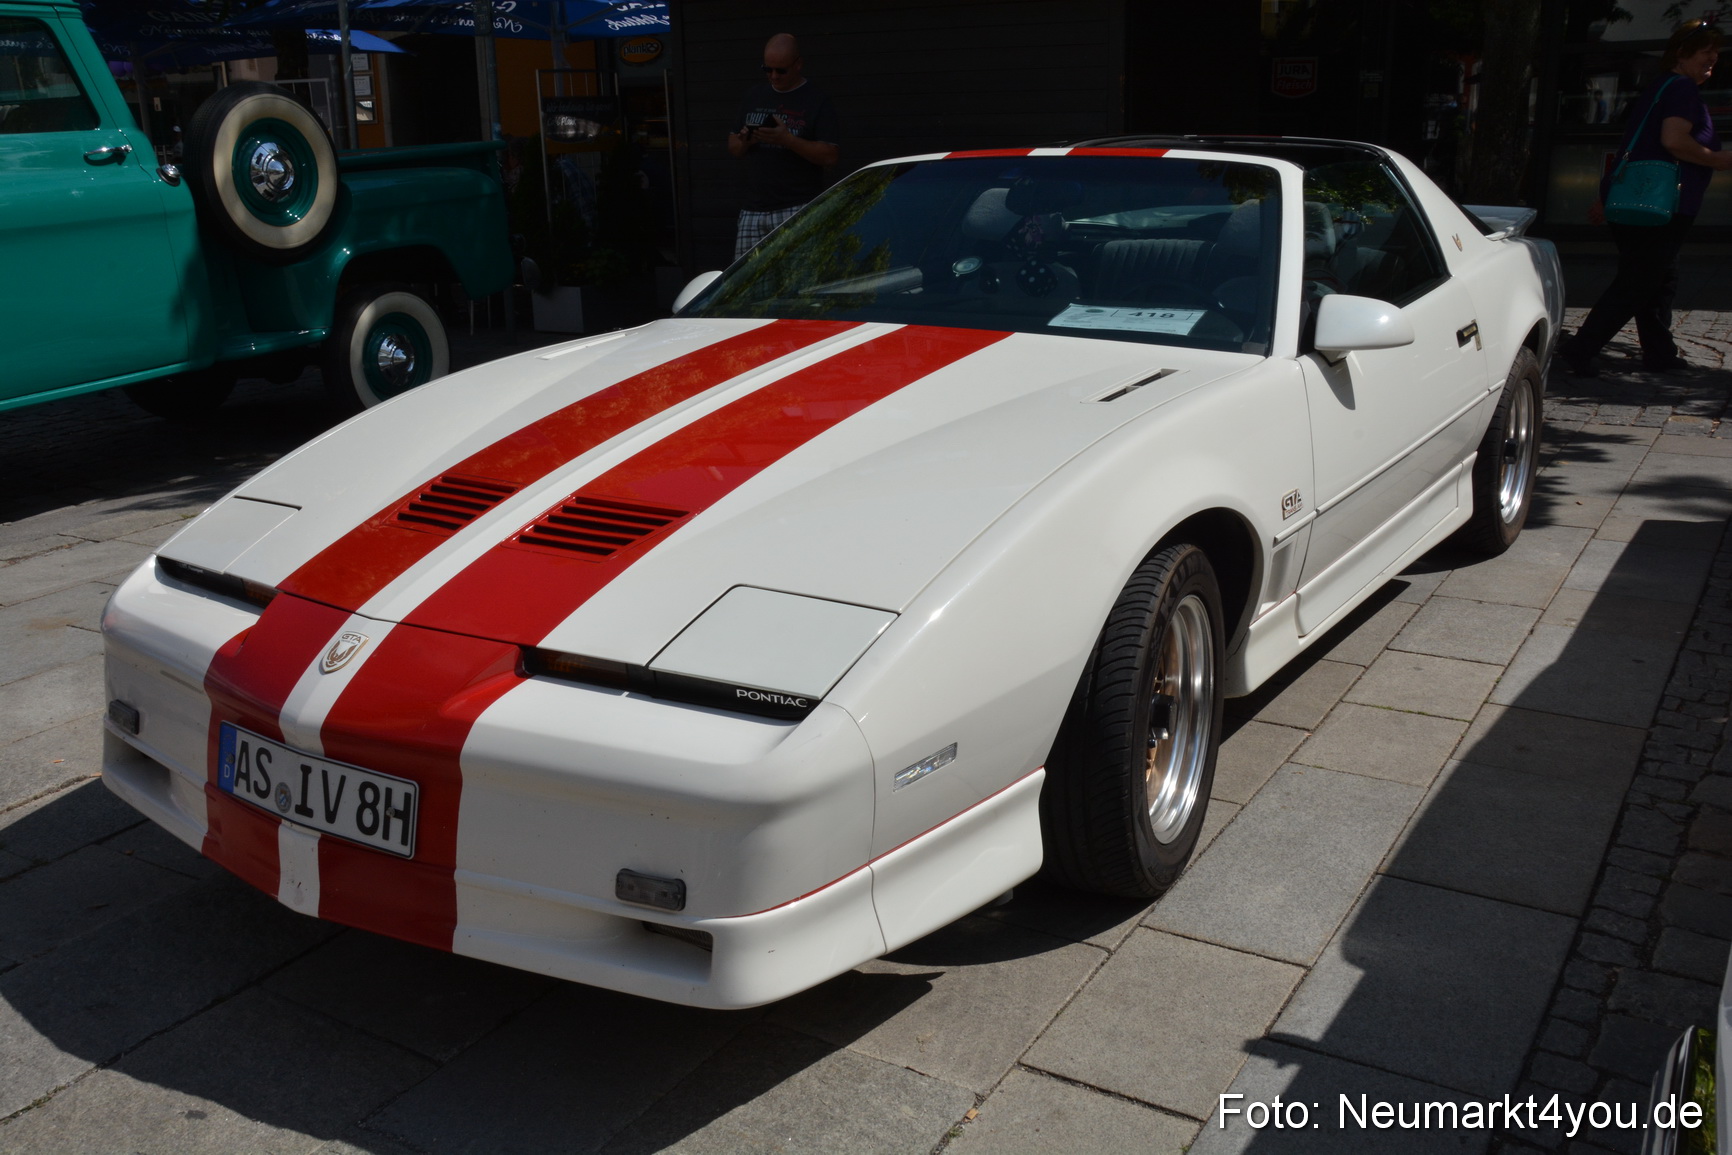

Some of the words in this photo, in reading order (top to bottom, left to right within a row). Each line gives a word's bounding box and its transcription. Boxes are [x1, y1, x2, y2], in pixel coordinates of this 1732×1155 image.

[1279, 65, 1310, 75] JURA
[1278, 79, 1312, 90] Fleisch
[341, 633, 362, 643] GTA
[736, 689, 808, 708] PONTIAC
[223, 767, 231, 779] D
[234, 740, 273, 800] AS
[294, 763, 347, 824] IV
[355, 781, 412, 847] 8H
